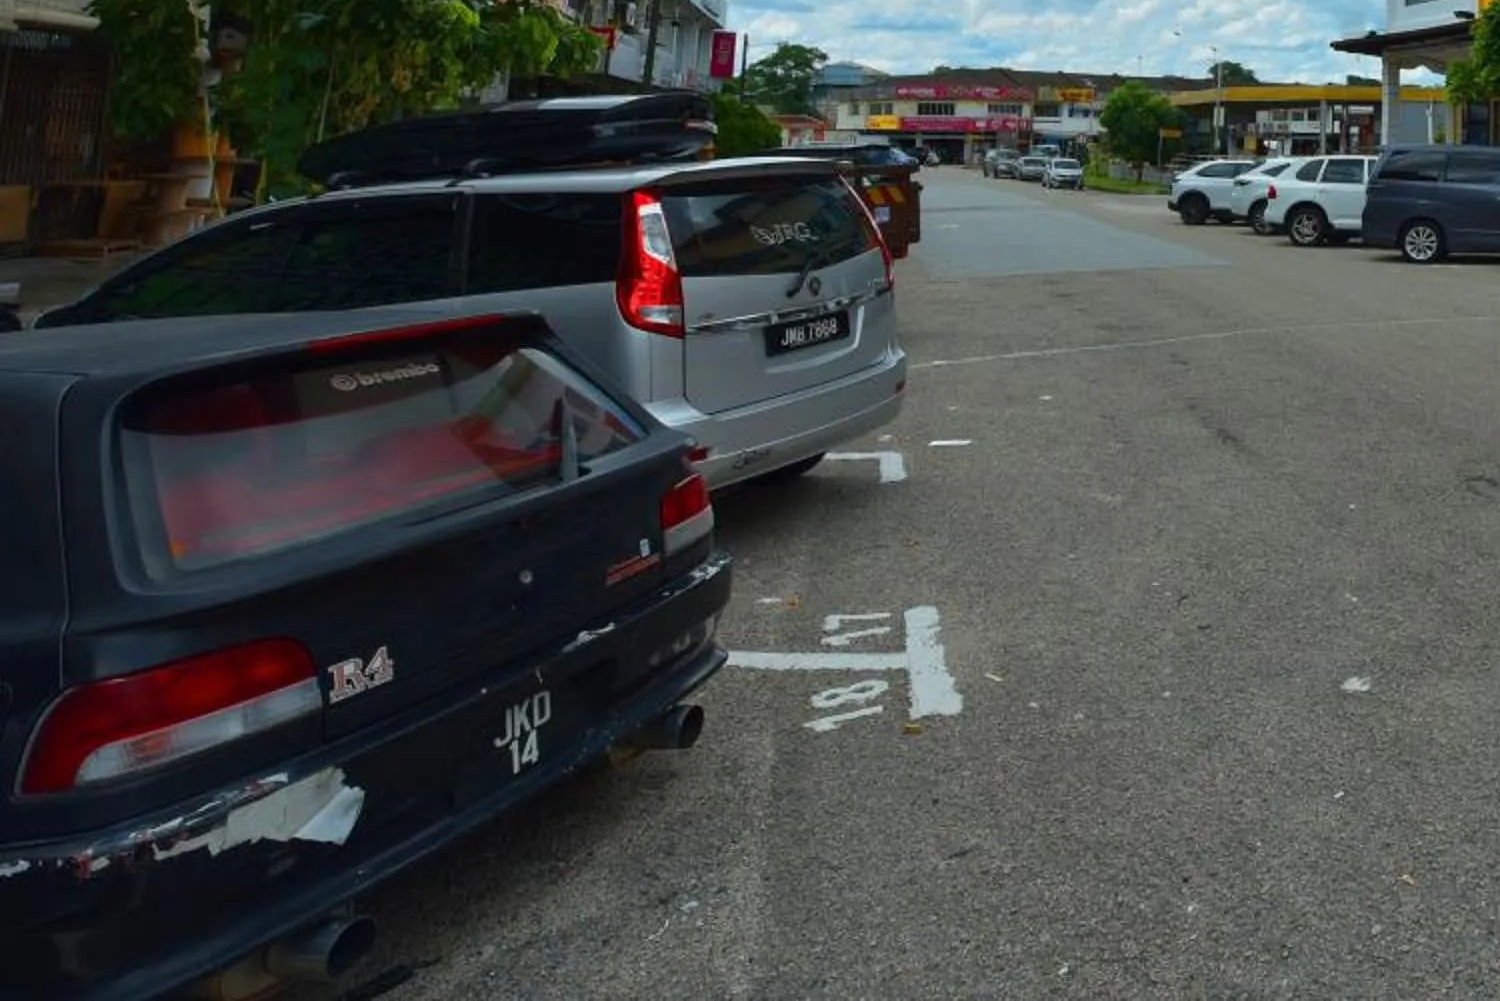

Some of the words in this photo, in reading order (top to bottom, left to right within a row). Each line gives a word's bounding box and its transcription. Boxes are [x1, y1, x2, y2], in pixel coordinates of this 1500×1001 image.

[355, 362, 440, 387] brembo
[327, 645, 395, 704] R4
[803, 679, 889, 733] 18
[508, 729, 541, 775] 14
